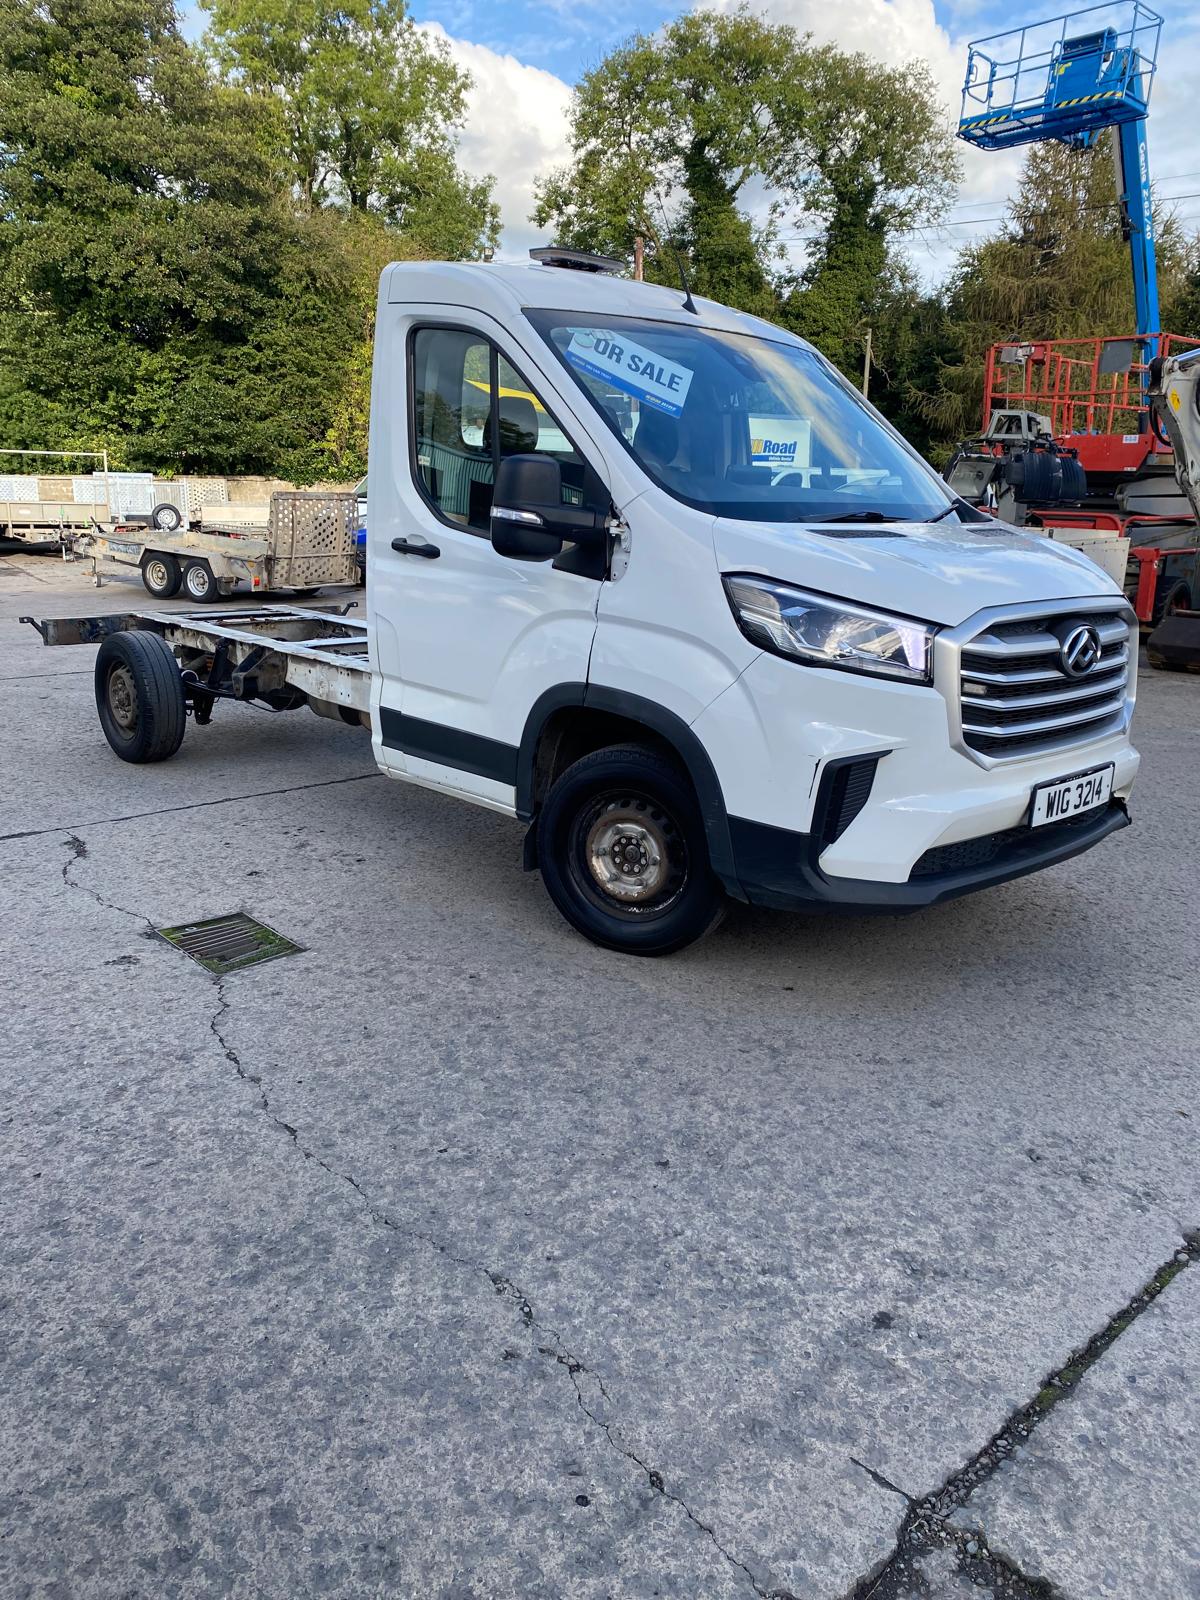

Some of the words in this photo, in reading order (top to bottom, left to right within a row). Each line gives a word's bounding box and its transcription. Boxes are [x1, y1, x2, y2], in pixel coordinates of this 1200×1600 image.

[1139, 142, 1148, 183] Genie
[593, 338, 625, 364] OR
[627, 354, 683, 393] SALE
[762, 440, 798, 455] Road
[1045, 787, 1072, 818] WIG
[1073, 775, 1104, 809] 3214
